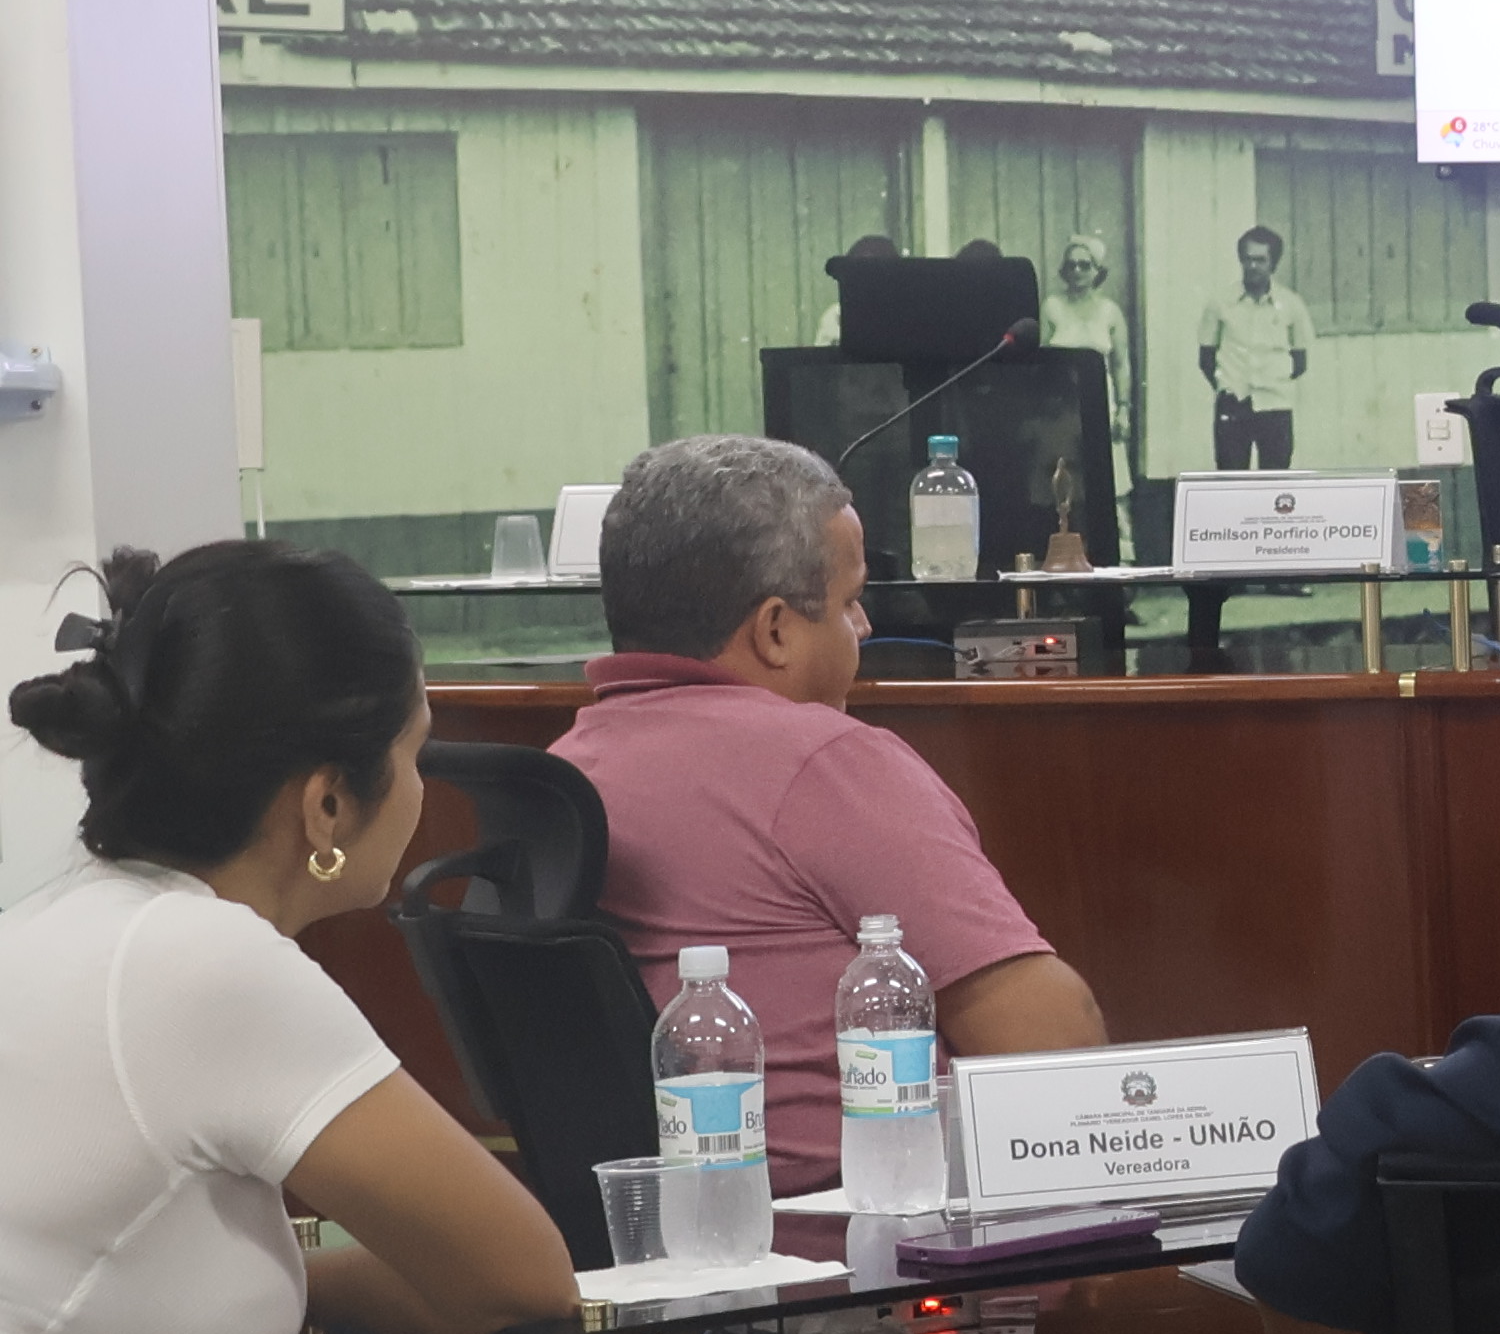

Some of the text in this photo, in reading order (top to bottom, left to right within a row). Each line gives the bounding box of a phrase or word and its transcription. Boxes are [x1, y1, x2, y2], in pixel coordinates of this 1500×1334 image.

[1472, 121, 1500, 133] 28°C
[1189, 529, 1259, 542] Edmilson
[1323, 525, 1378, 541] (PODE)
[1255, 546, 1311, 555] Presidente
[1009, 1136, 1081, 1160] Dona
[1090, 1129, 1164, 1154] Neide
[1190, 1116, 1277, 1146] UNIÃO
[1104, 1157, 1190, 1176] Vereadora
